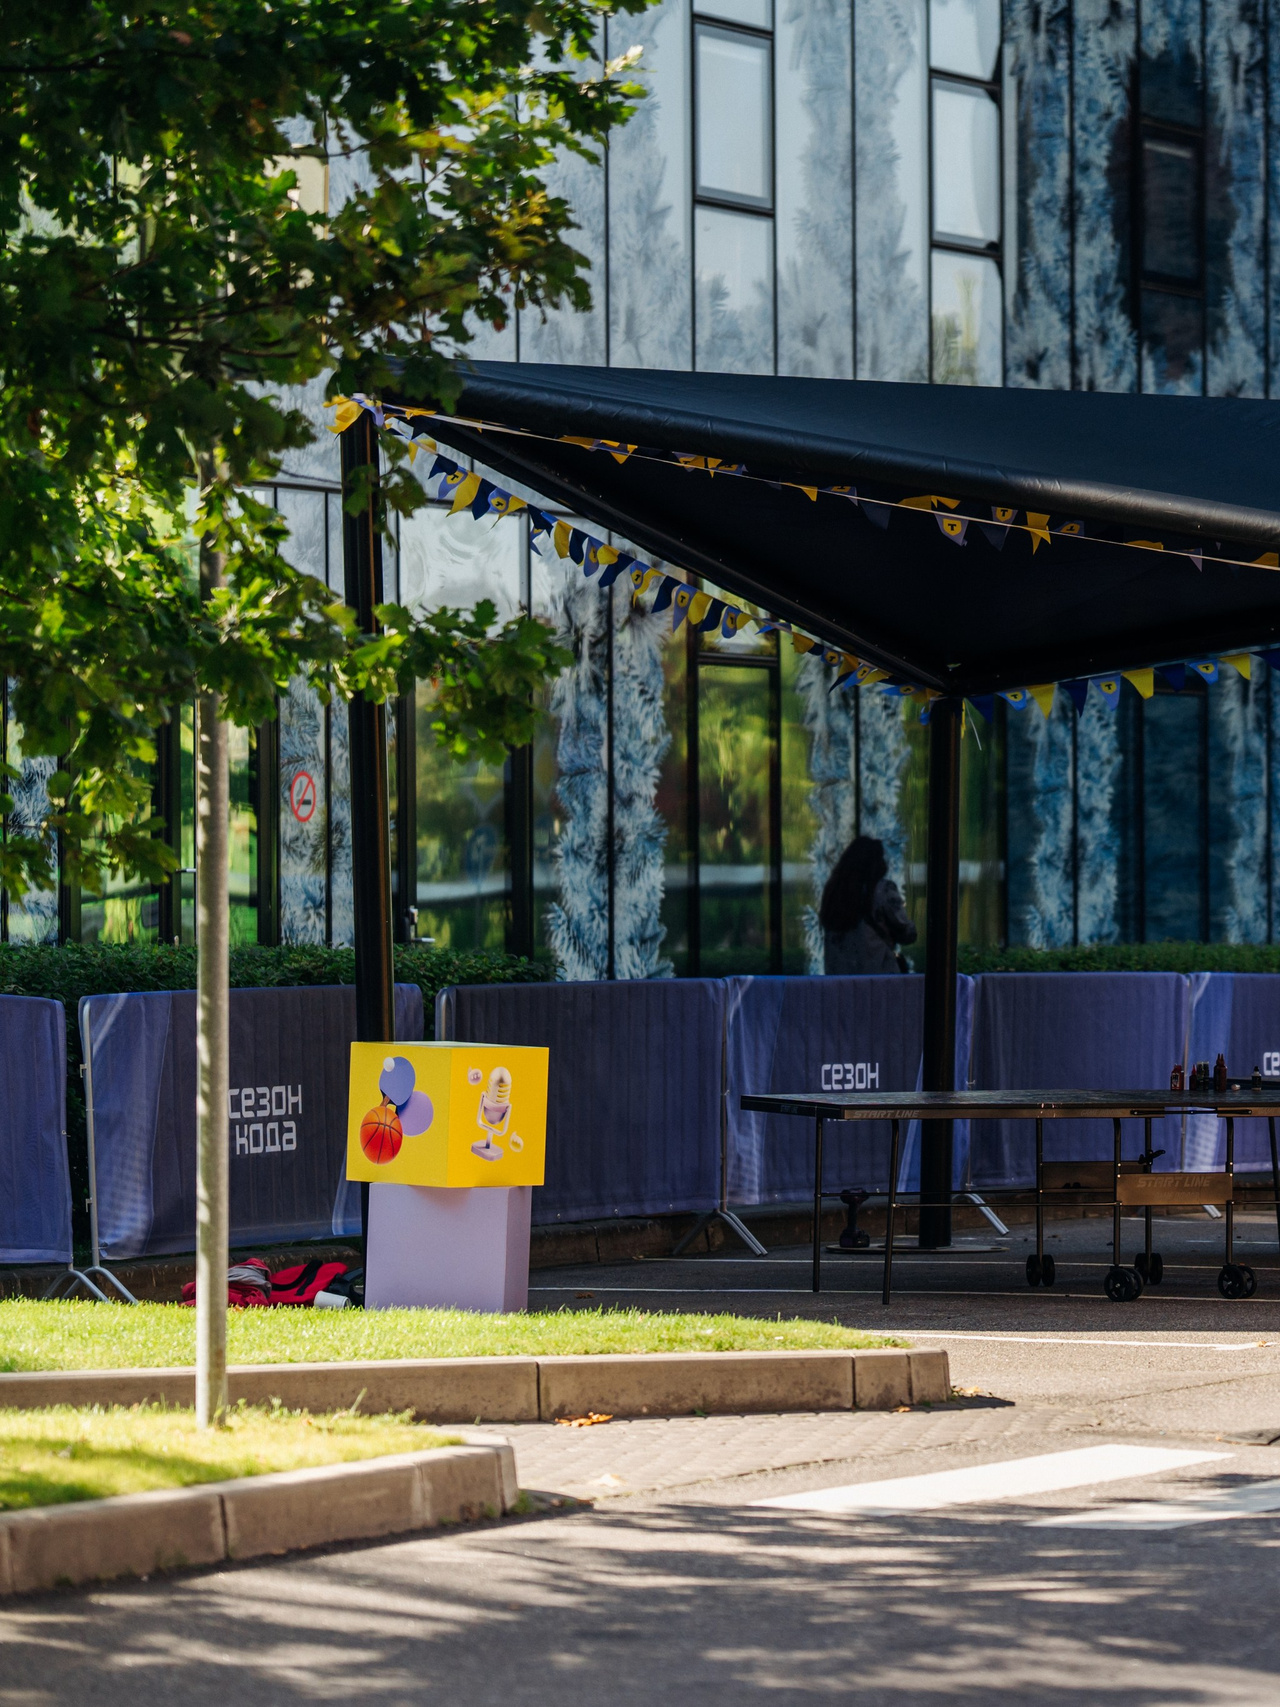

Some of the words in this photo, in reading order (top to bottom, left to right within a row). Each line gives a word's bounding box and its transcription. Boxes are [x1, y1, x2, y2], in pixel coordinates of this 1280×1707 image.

[854, 1110, 895, 1118] START
[894, 1110, 921, 1118] LINE
[1136, 1176, 1183, 1188] START
[1183, 1176, 1212, 1188] LINE
